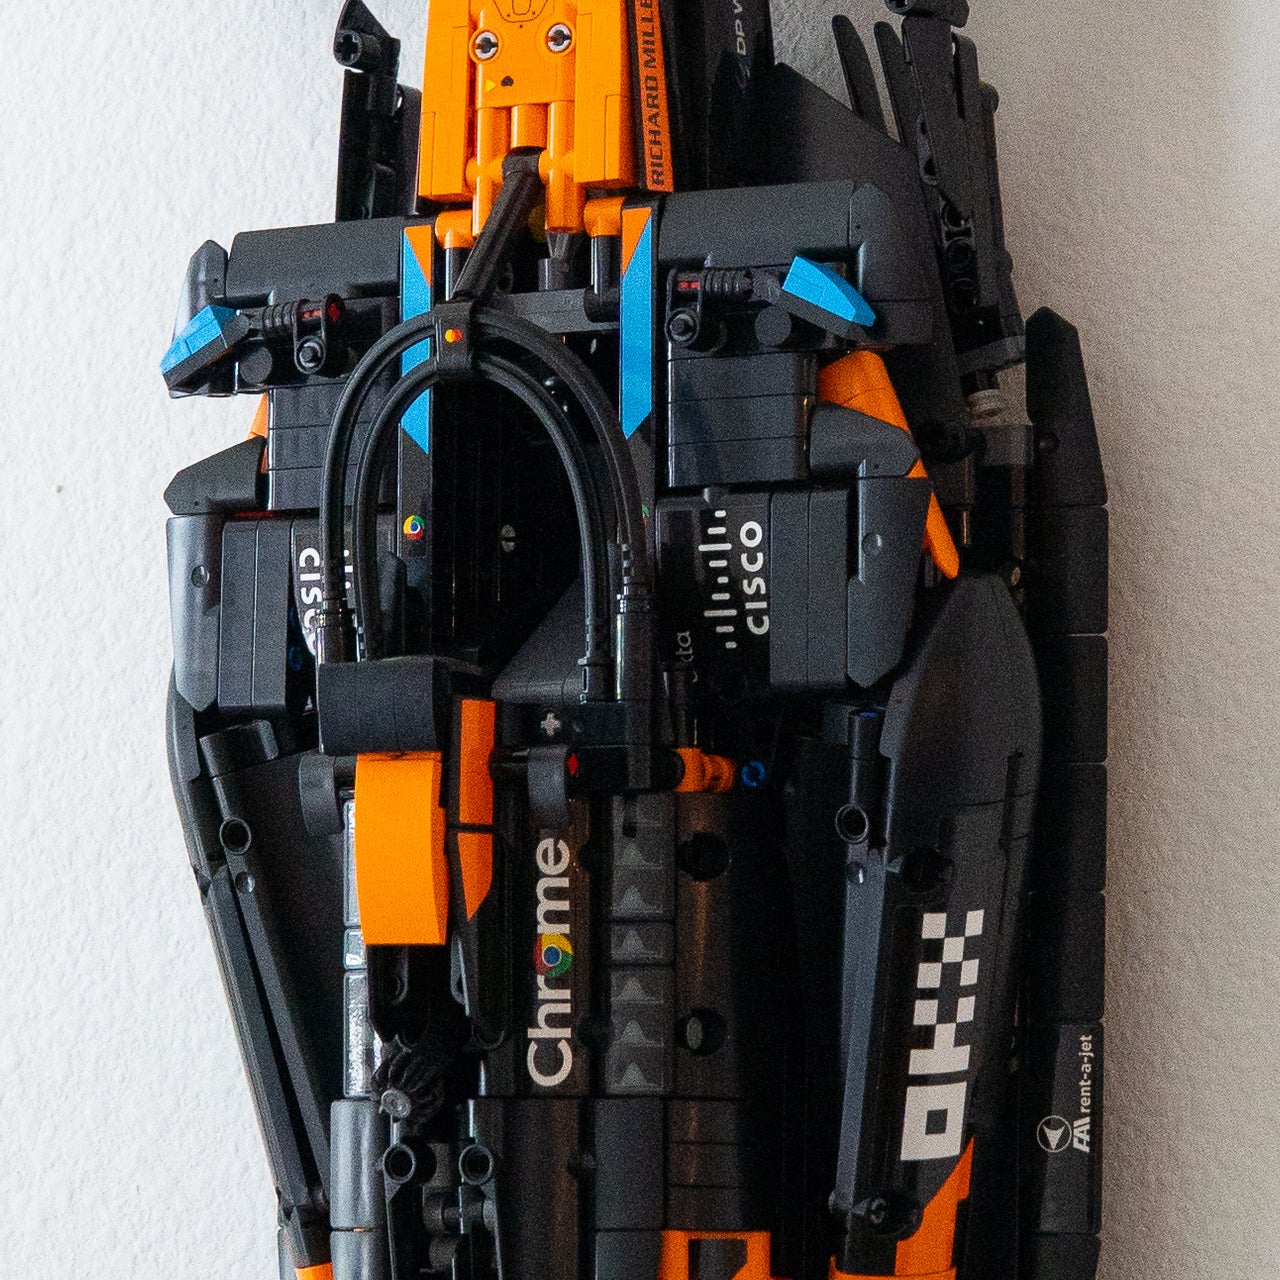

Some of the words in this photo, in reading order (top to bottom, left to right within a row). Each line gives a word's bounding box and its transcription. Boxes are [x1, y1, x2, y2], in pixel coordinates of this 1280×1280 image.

[734, 19, 747, 56] DP
[645, 75, 665, 186] RICHARD
[527, 838, 574, 1087] Chrome
[901, 909, 984, 1161] OKX
[1079, 1034, 1095, 1113] rent-a-jet
